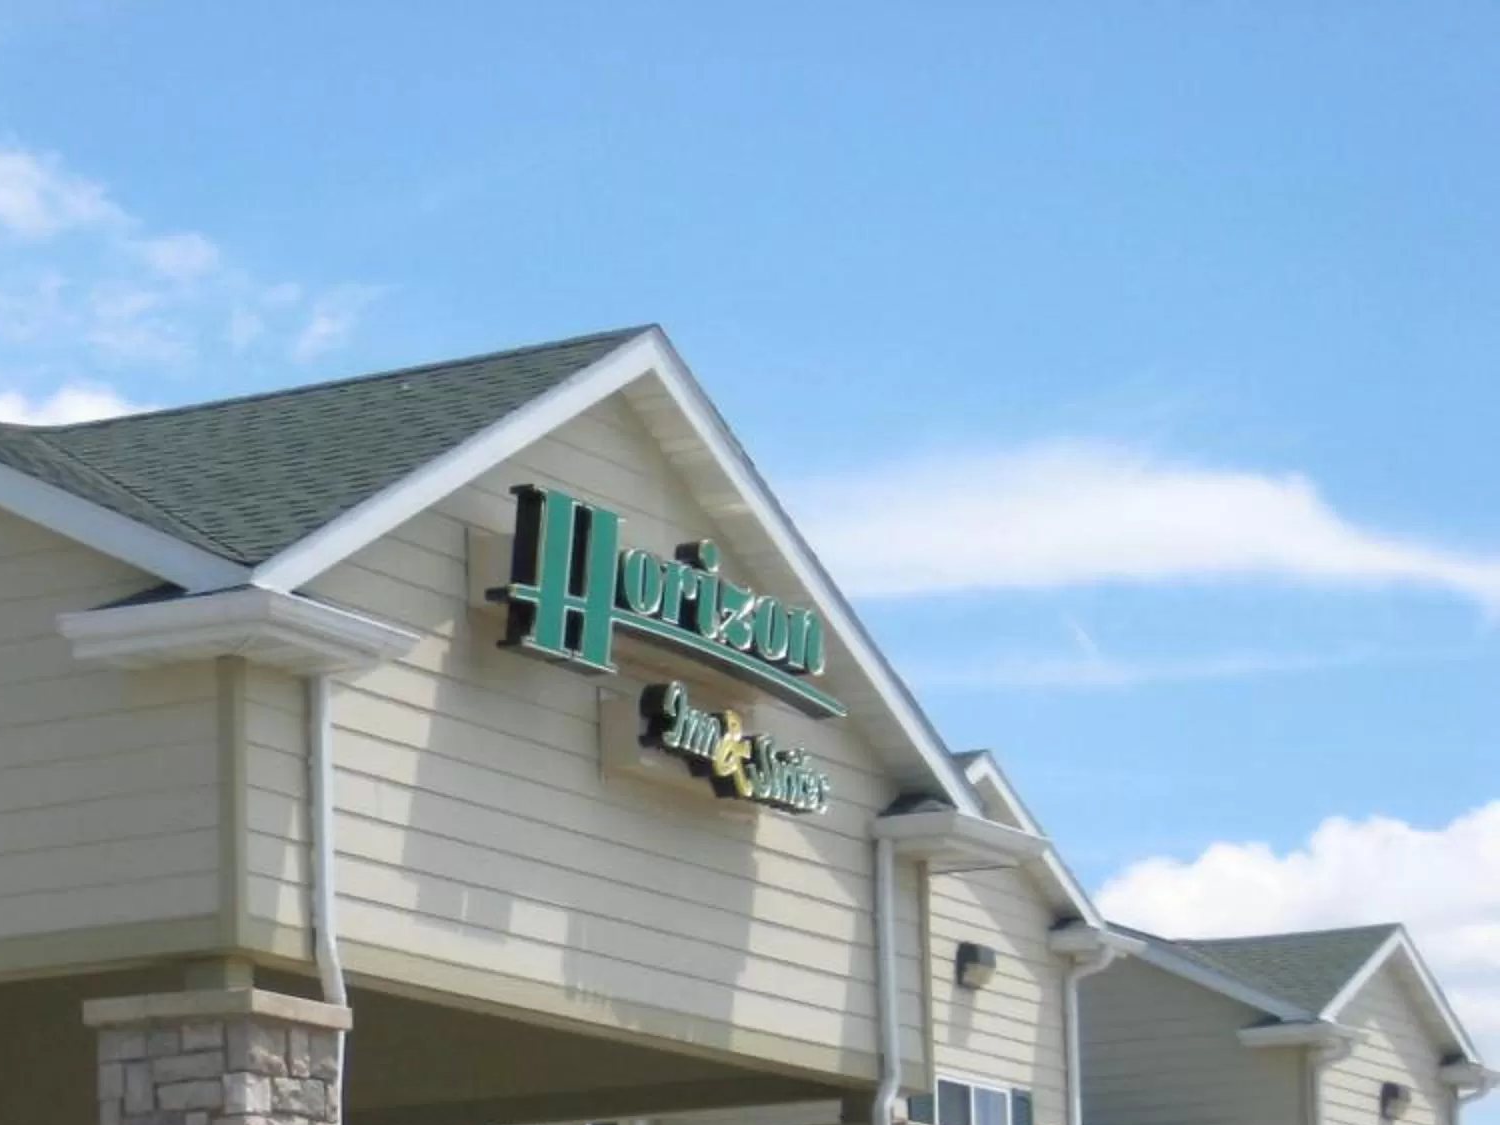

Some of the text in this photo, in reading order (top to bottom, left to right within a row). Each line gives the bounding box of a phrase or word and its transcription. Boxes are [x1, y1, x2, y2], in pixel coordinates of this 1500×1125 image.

[520, 485, 828, 675] Horizon
[662, 680, 831, 815] Inn & Suites
